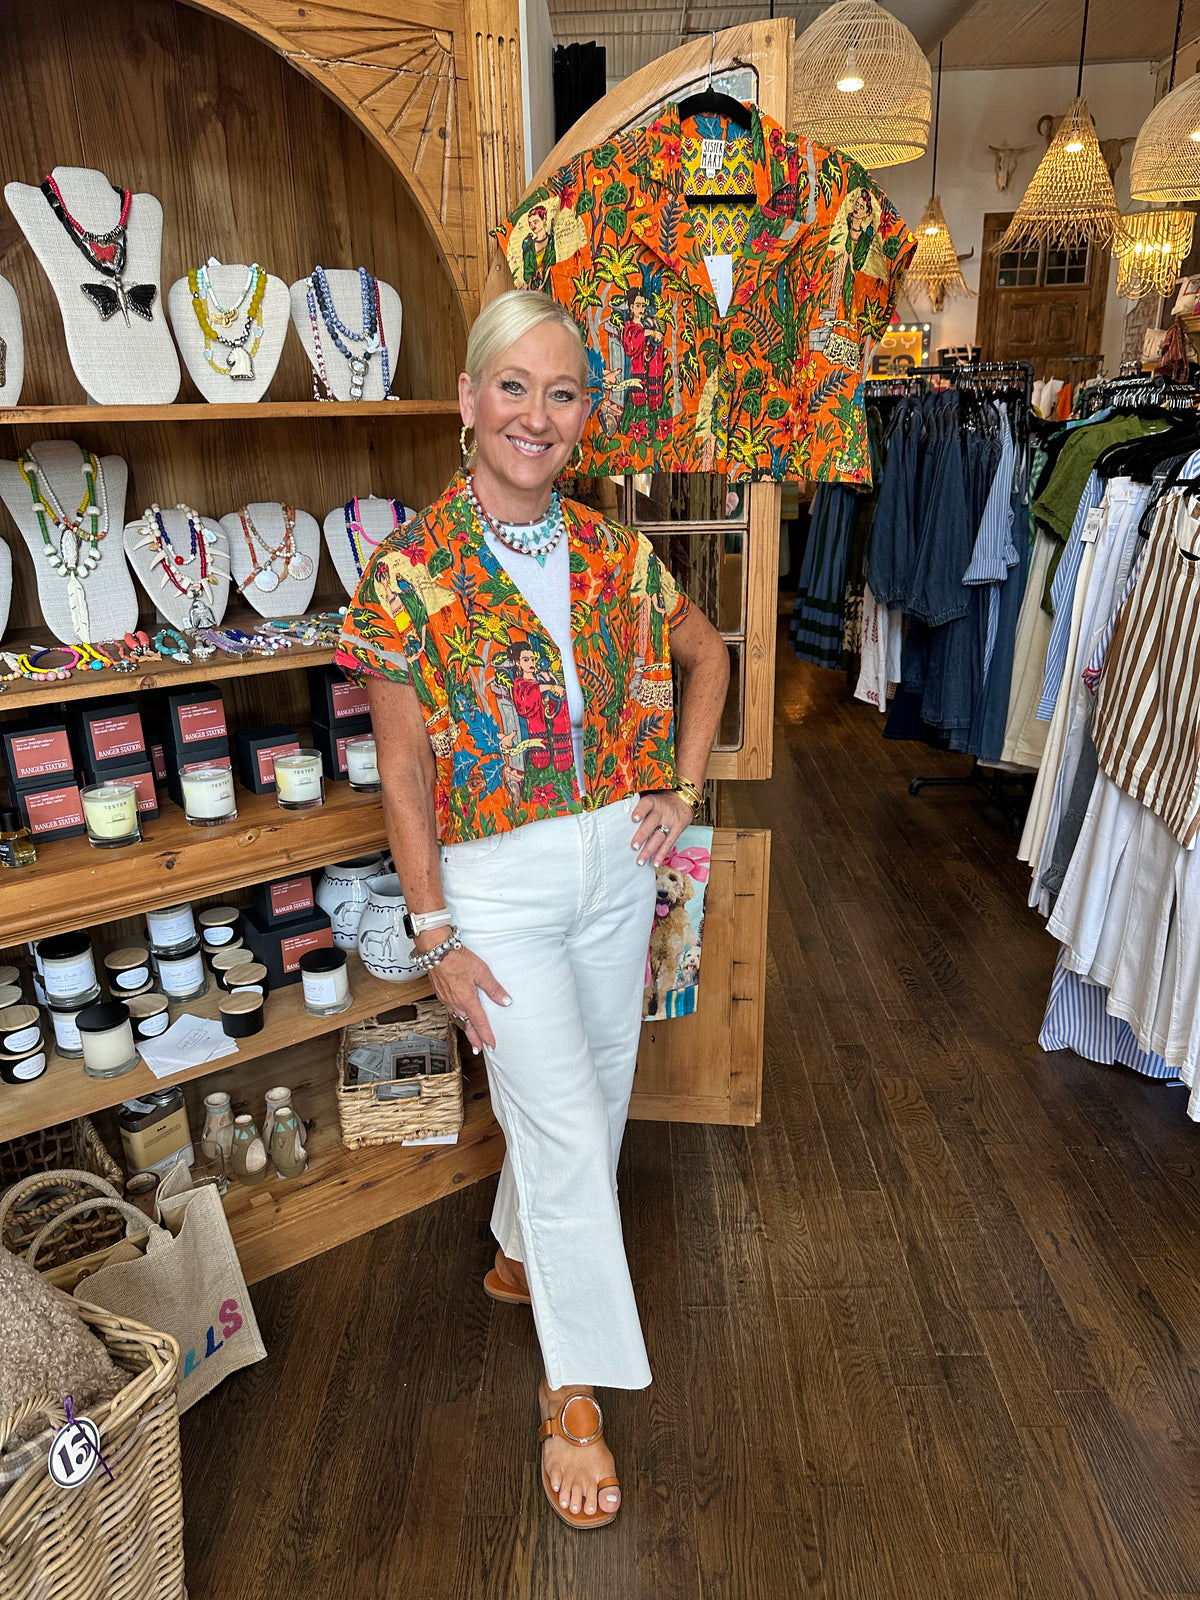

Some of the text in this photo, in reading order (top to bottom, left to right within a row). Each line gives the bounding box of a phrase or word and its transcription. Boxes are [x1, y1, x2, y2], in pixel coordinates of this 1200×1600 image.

[703, 141, 723, 154] SISTER
[701, 153, 722, 168] MARY
[184, 731, 206, 741] RANGER
[205, 727, 226, 738] STATION
[98, 747, 120, 758] RANGER
[119, 743, 142, 753] STATION
[20, 764, 45, 776] RANGER
[44, 761, 68, 772] STATION
[294, 767, 314, 775] TESTER
[211, 780, 230, 789] TESTER
[104, 801, 127, 811] TESTER
[138, 800, 155, 810] ATION
[34, 821, 59, 832] RANGER
[58, 815, 81, 826] STATION
[275, 903, 293, 914] RANGER
[292, 900, 311, 910] STATION
[286, 962, 300, 971] RANG
[58, 1427, 92, 1479] 15
